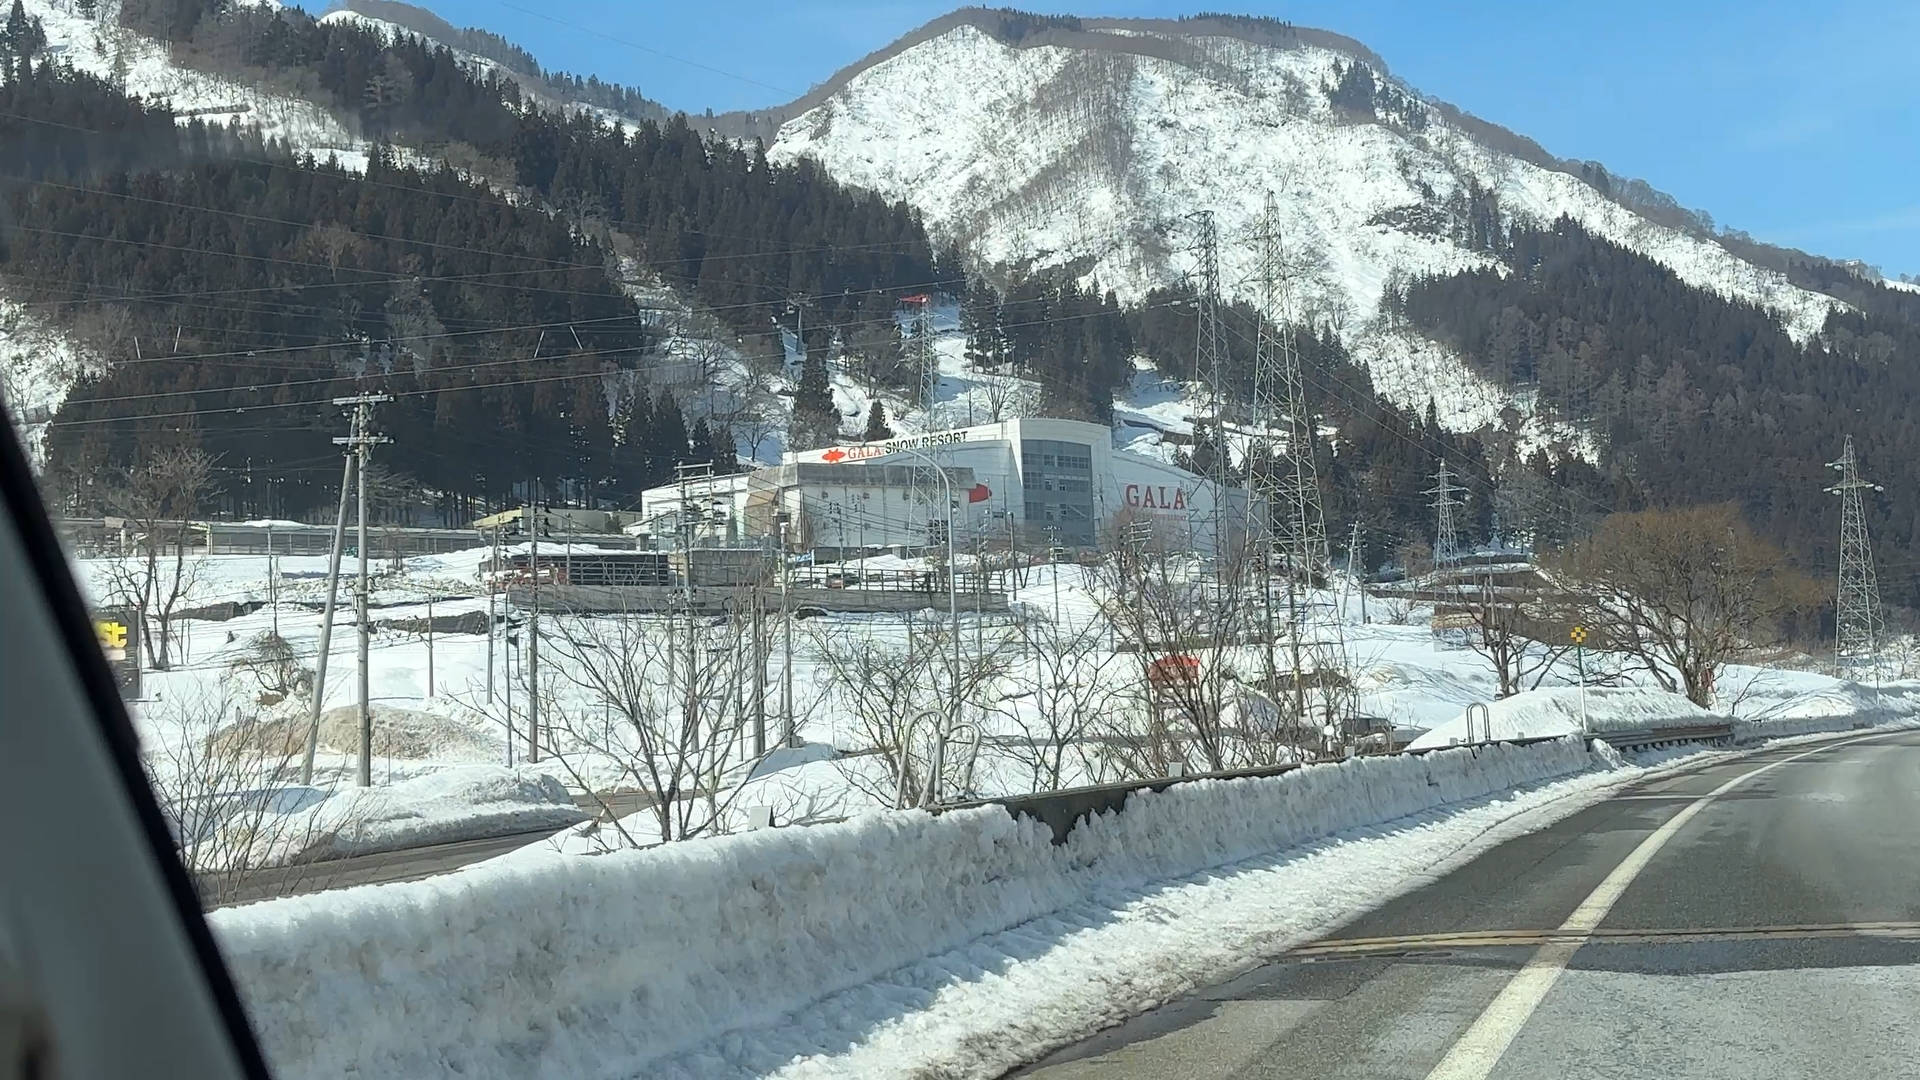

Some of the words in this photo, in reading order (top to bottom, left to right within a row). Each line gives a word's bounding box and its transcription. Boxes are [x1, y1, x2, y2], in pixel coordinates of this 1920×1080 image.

[848, 446, 881, 459] GALA
[885, 438, 919, 454] SNOW
[922, 431, 968, 448] RESORT
[1126, 484, 1186, 510] GALA
